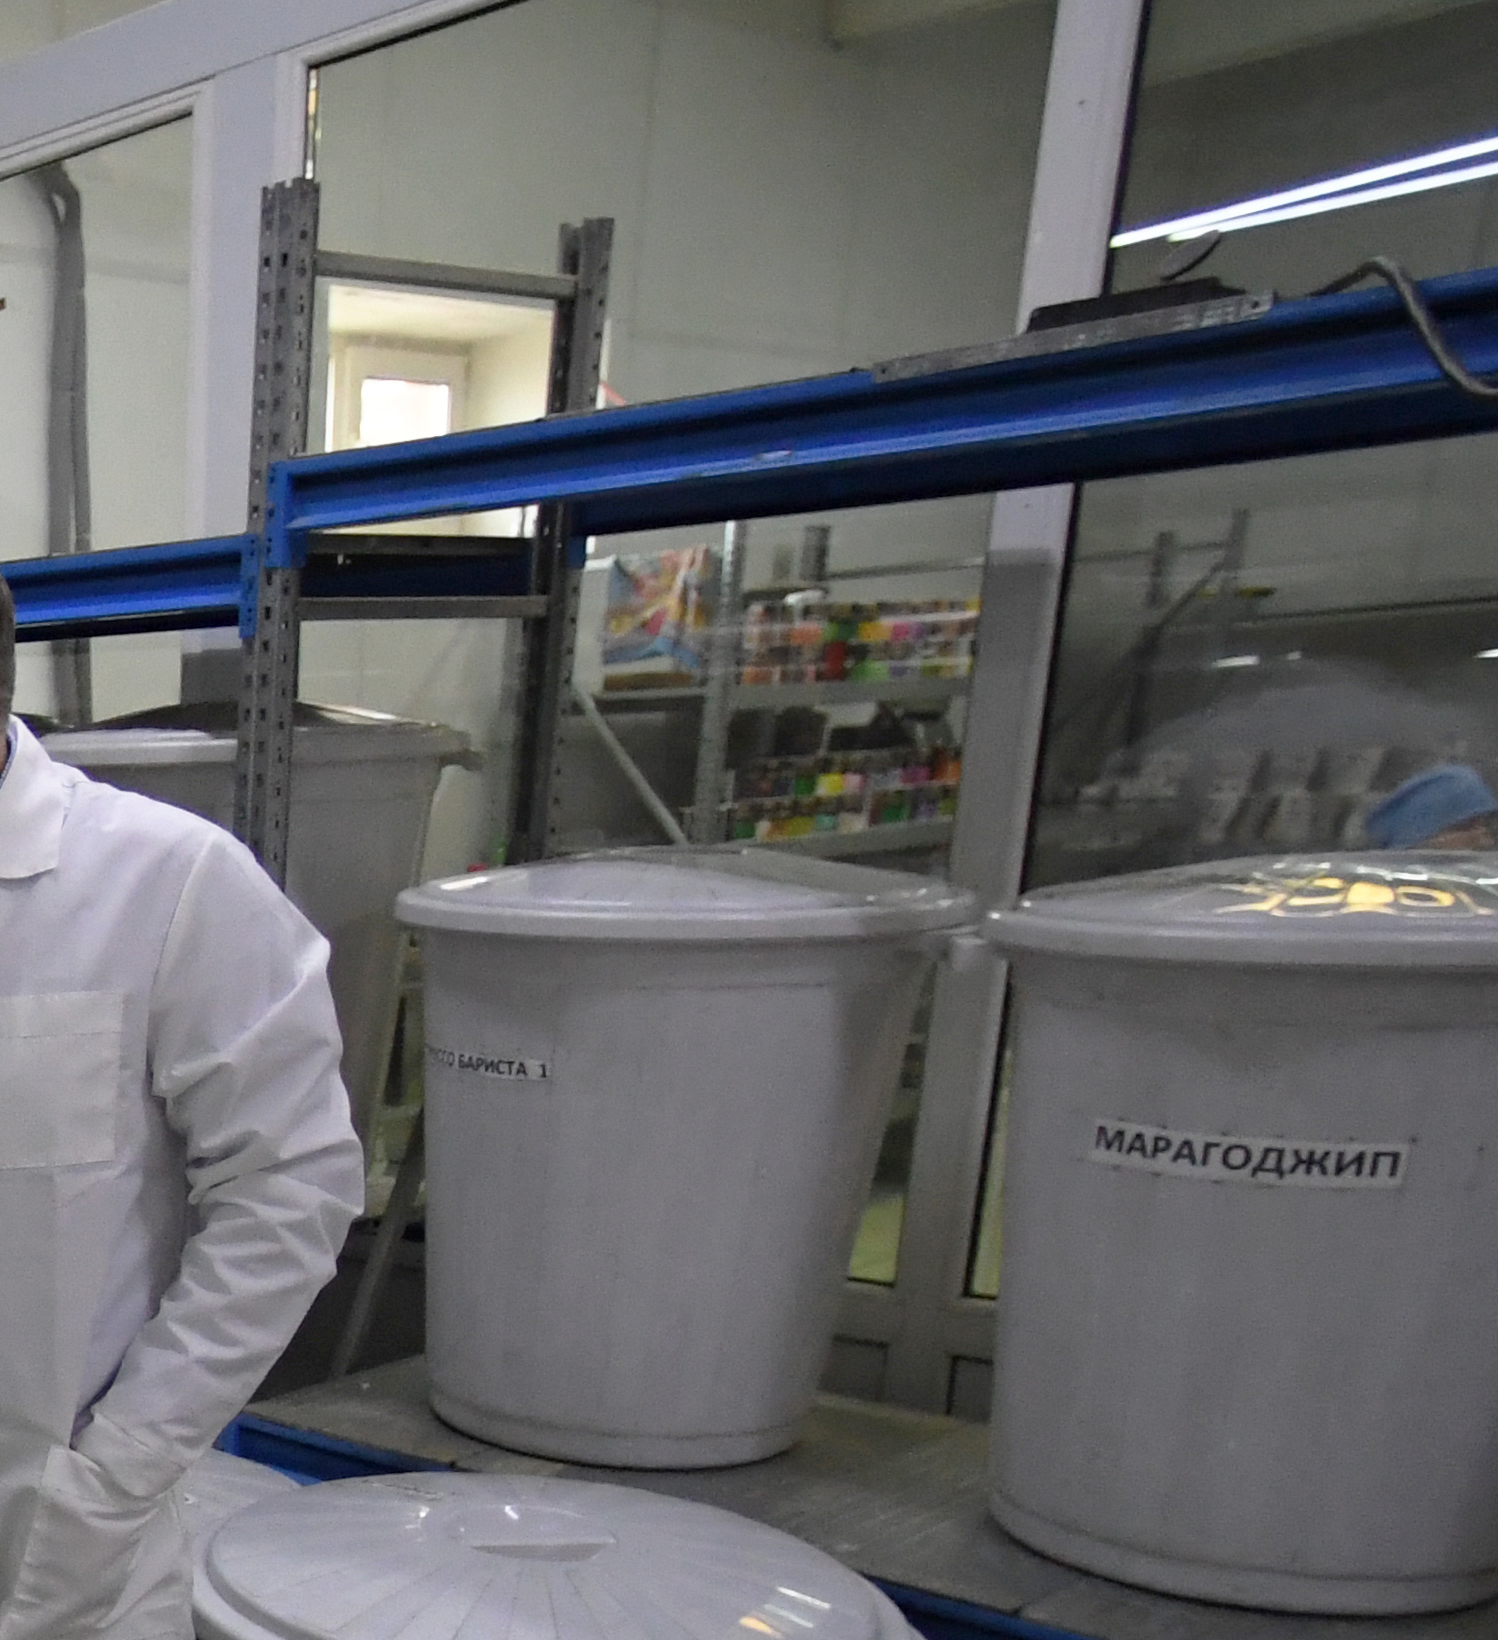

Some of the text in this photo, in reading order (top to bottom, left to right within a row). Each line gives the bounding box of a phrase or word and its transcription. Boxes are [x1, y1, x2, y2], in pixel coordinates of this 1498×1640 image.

[458, 1053, 528, 1077] БАРИСТА
[539, 1064, 548, 1078] 1
[1095, 1125, 1401, 1178] МАРАГОДЖИП
